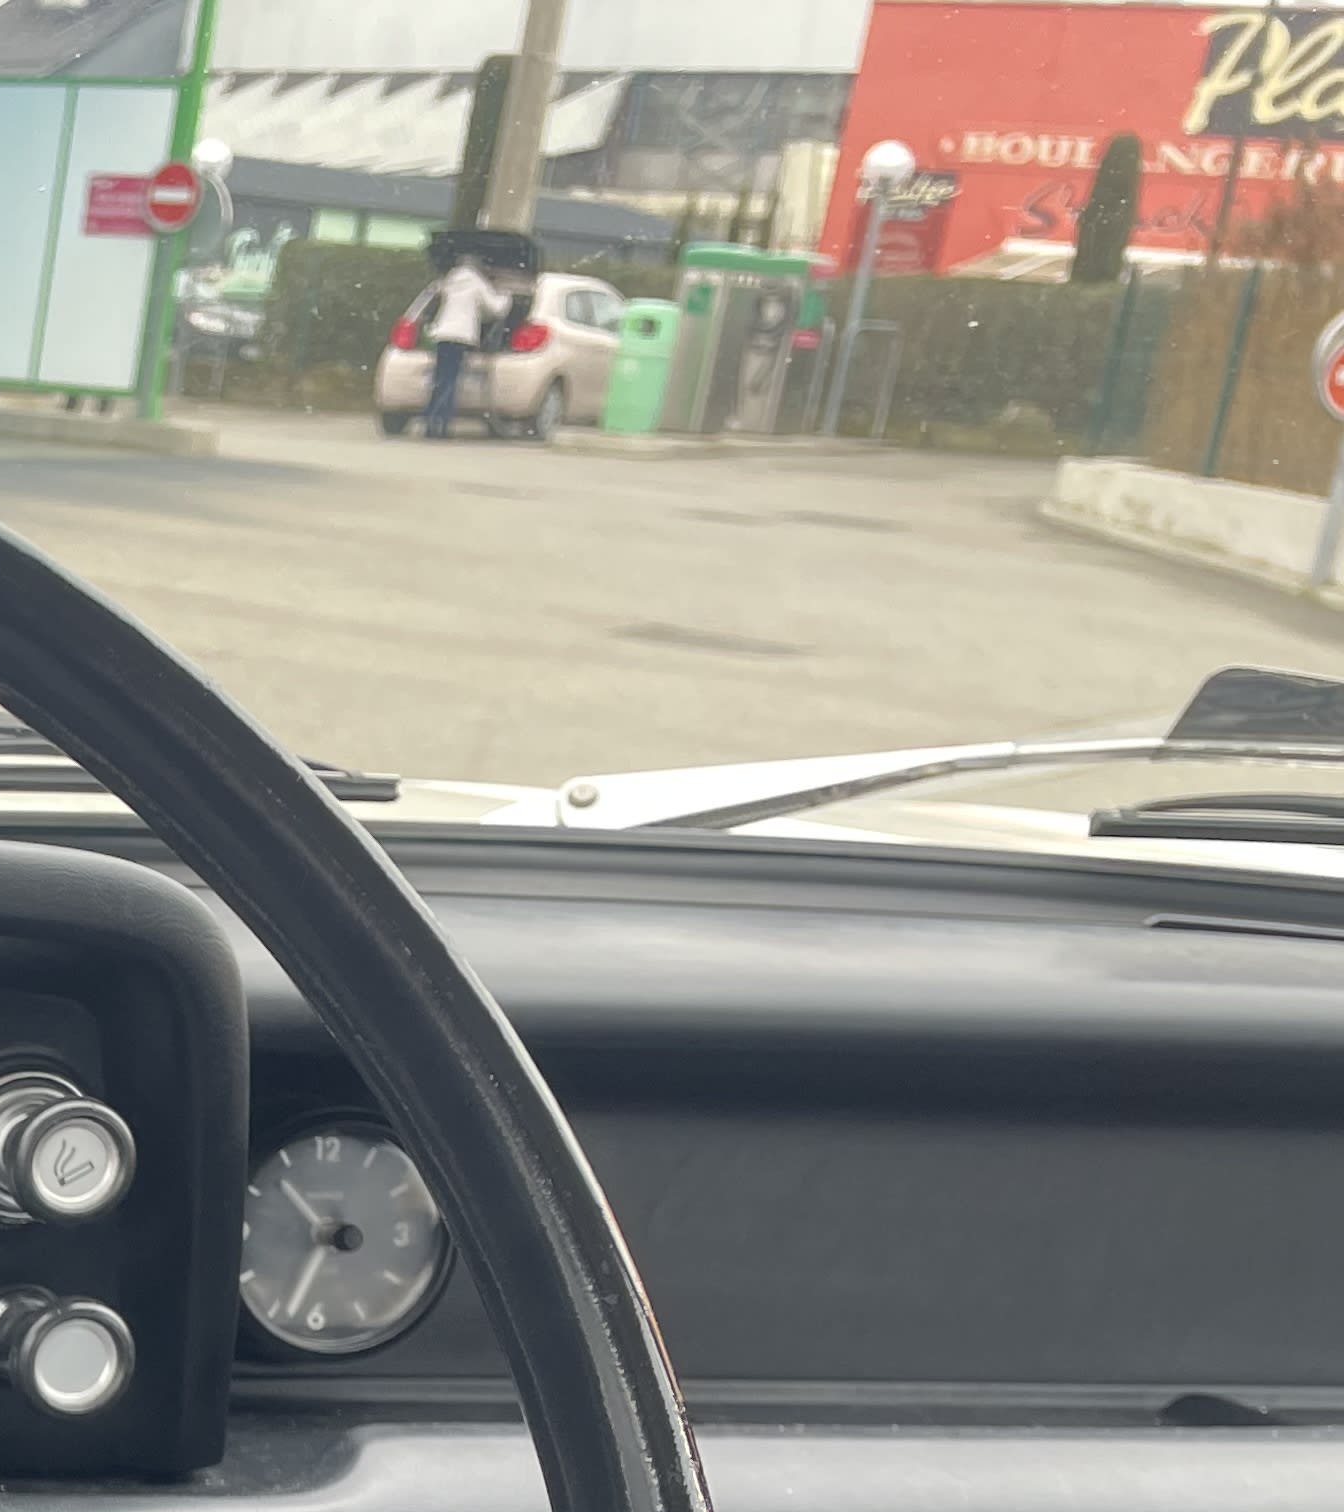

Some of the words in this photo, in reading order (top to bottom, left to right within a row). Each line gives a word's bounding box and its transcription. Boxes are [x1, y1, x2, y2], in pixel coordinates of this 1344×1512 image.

[314, 1136, 341, 1162] 12
[393, 1221, 410, 1247] 3
[306, 1302, 326, 1331] 6
